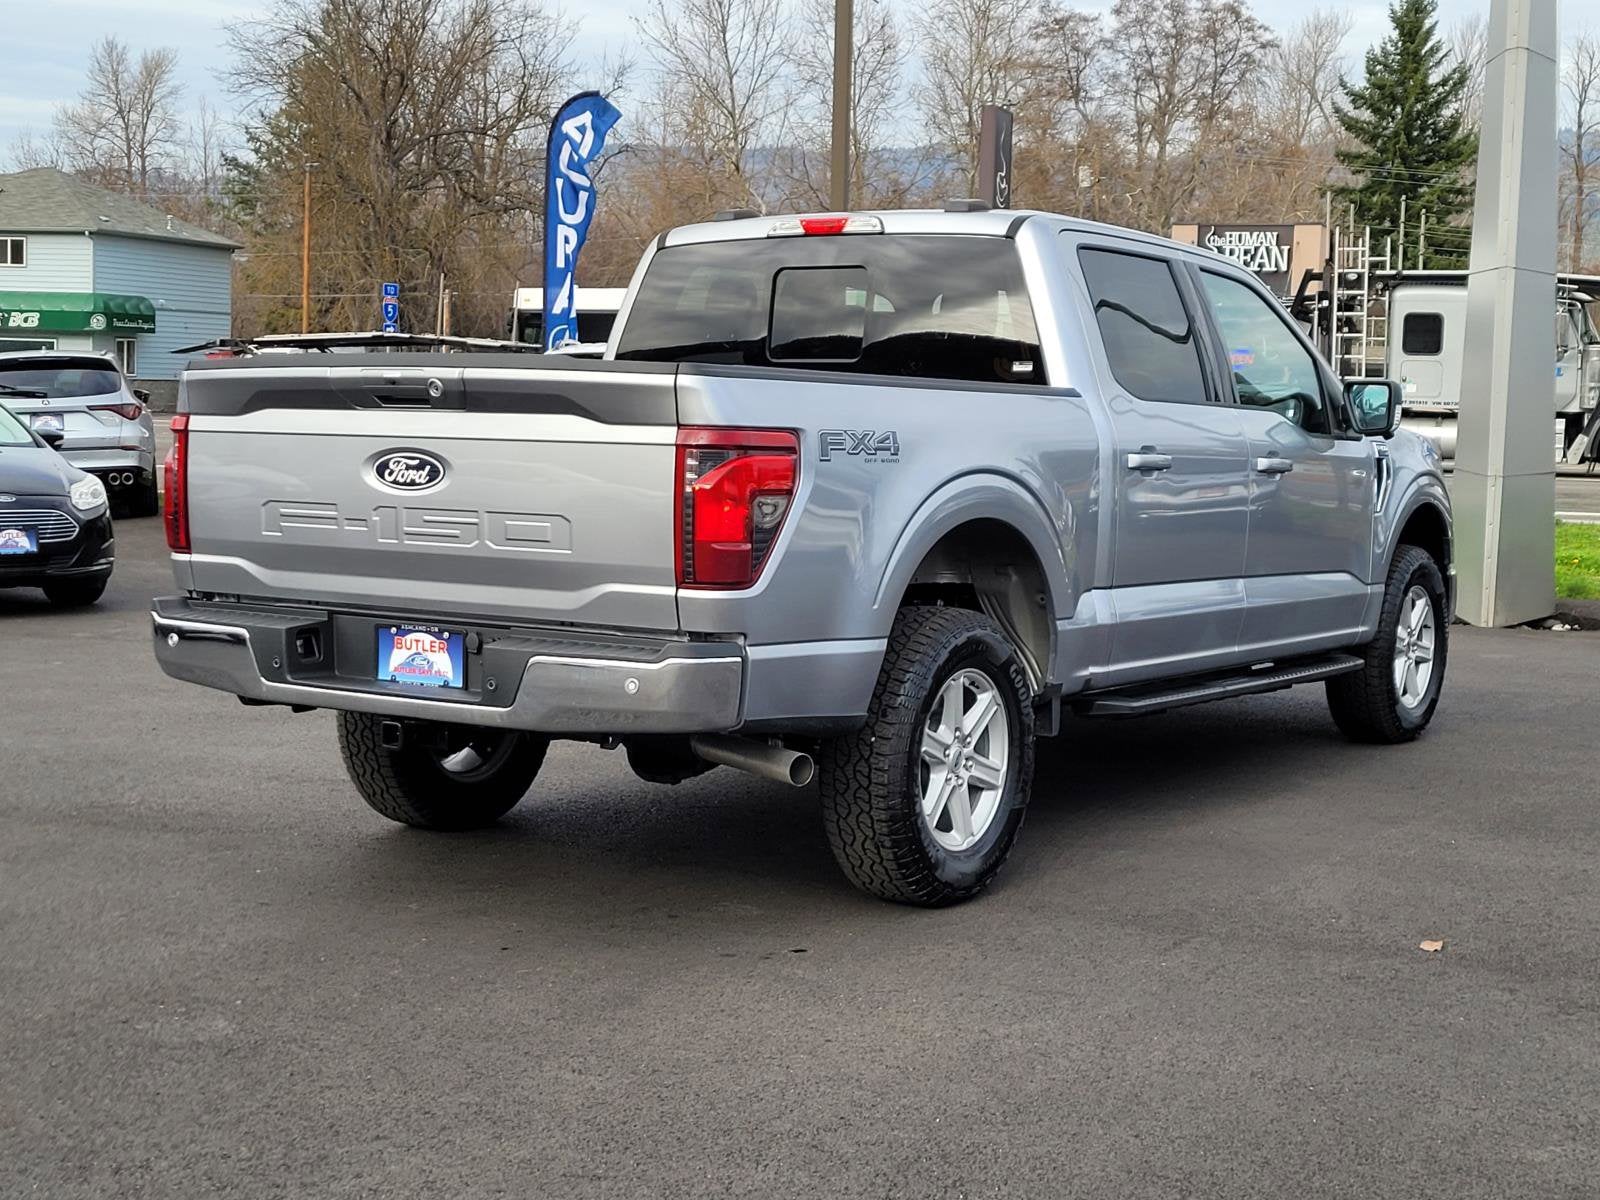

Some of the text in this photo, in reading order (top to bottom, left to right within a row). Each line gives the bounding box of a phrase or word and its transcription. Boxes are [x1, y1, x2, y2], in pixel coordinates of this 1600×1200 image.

[552, 111, 595, 318] ACURA
[1225, 232, 1278, 246] HUMAN
[1223, 246, 1290, 271] BEAN
[388, 305, 393, 317] 5
[818, 429, 900, 462] FX4
[384, 457, 430, 484] Ford
[261, 500, 573, 554] F-150
[395, 637, 447, 654] BUTLER
